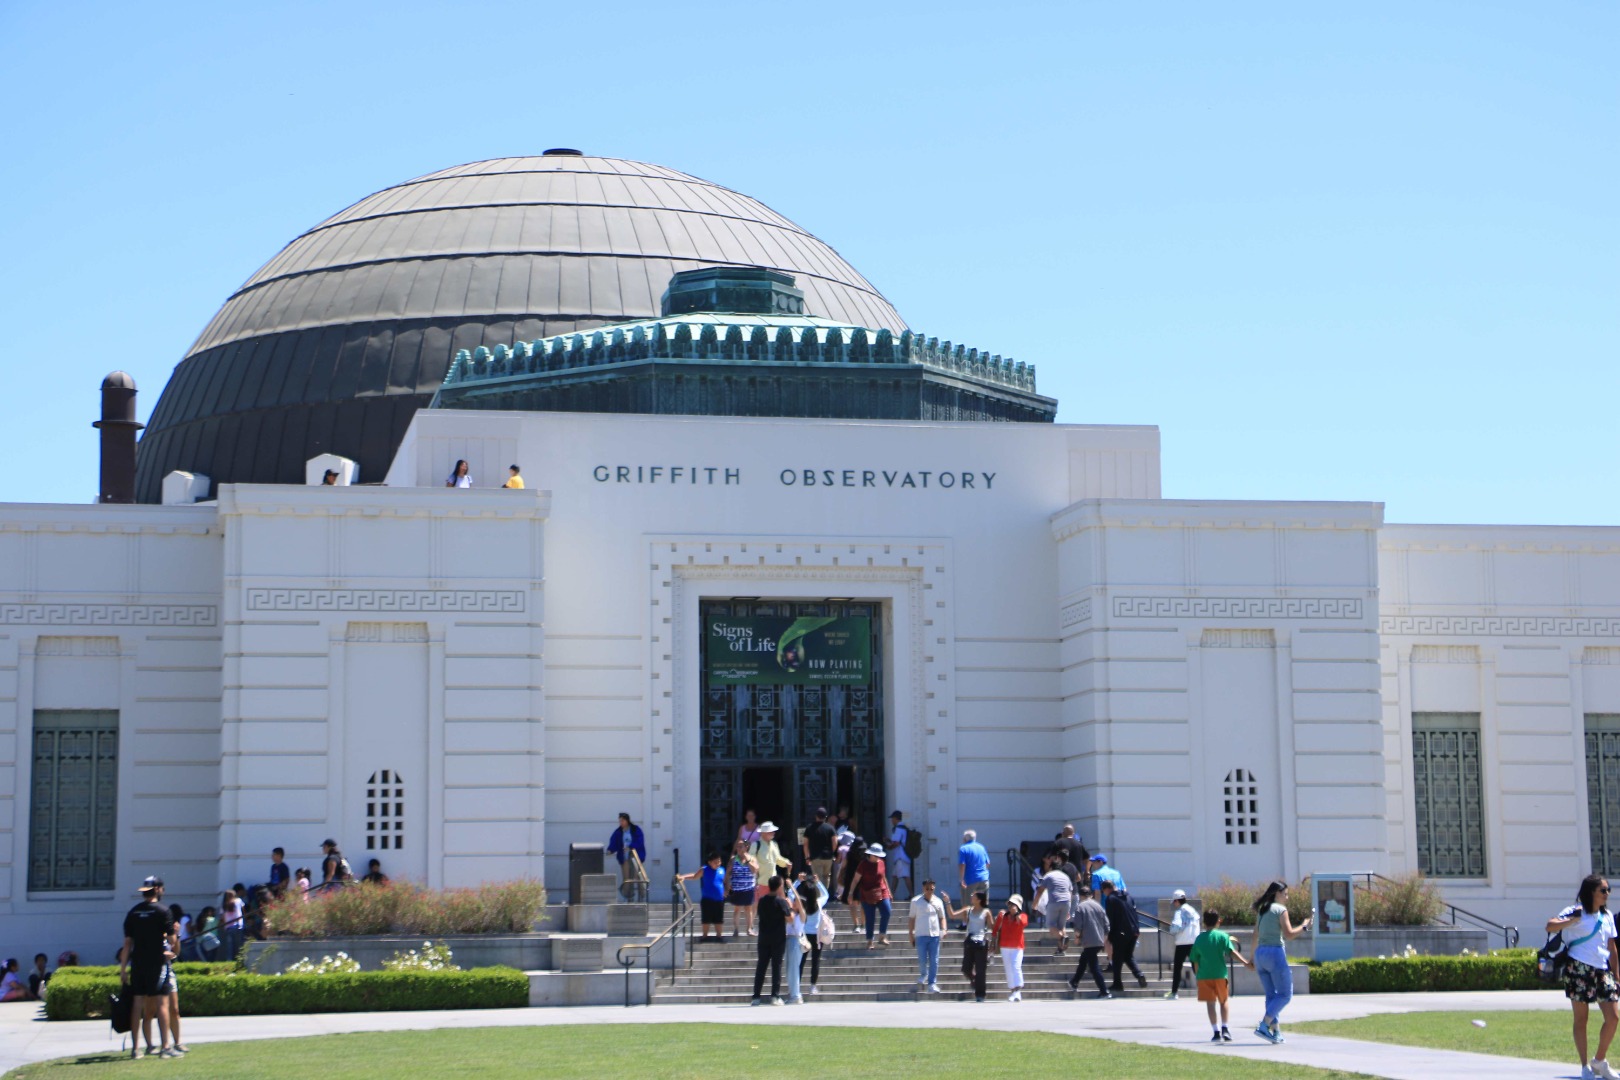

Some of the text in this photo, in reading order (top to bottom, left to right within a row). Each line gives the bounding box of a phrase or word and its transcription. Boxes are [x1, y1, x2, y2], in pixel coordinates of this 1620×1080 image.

[593, 465, 997, 489] GRIFFITH OBSERVATORY
[712, 622, 753, 642] Signs
[729, 637, 776, 652] of Life
[808, 659, 863, 669] NOW PLAYING
